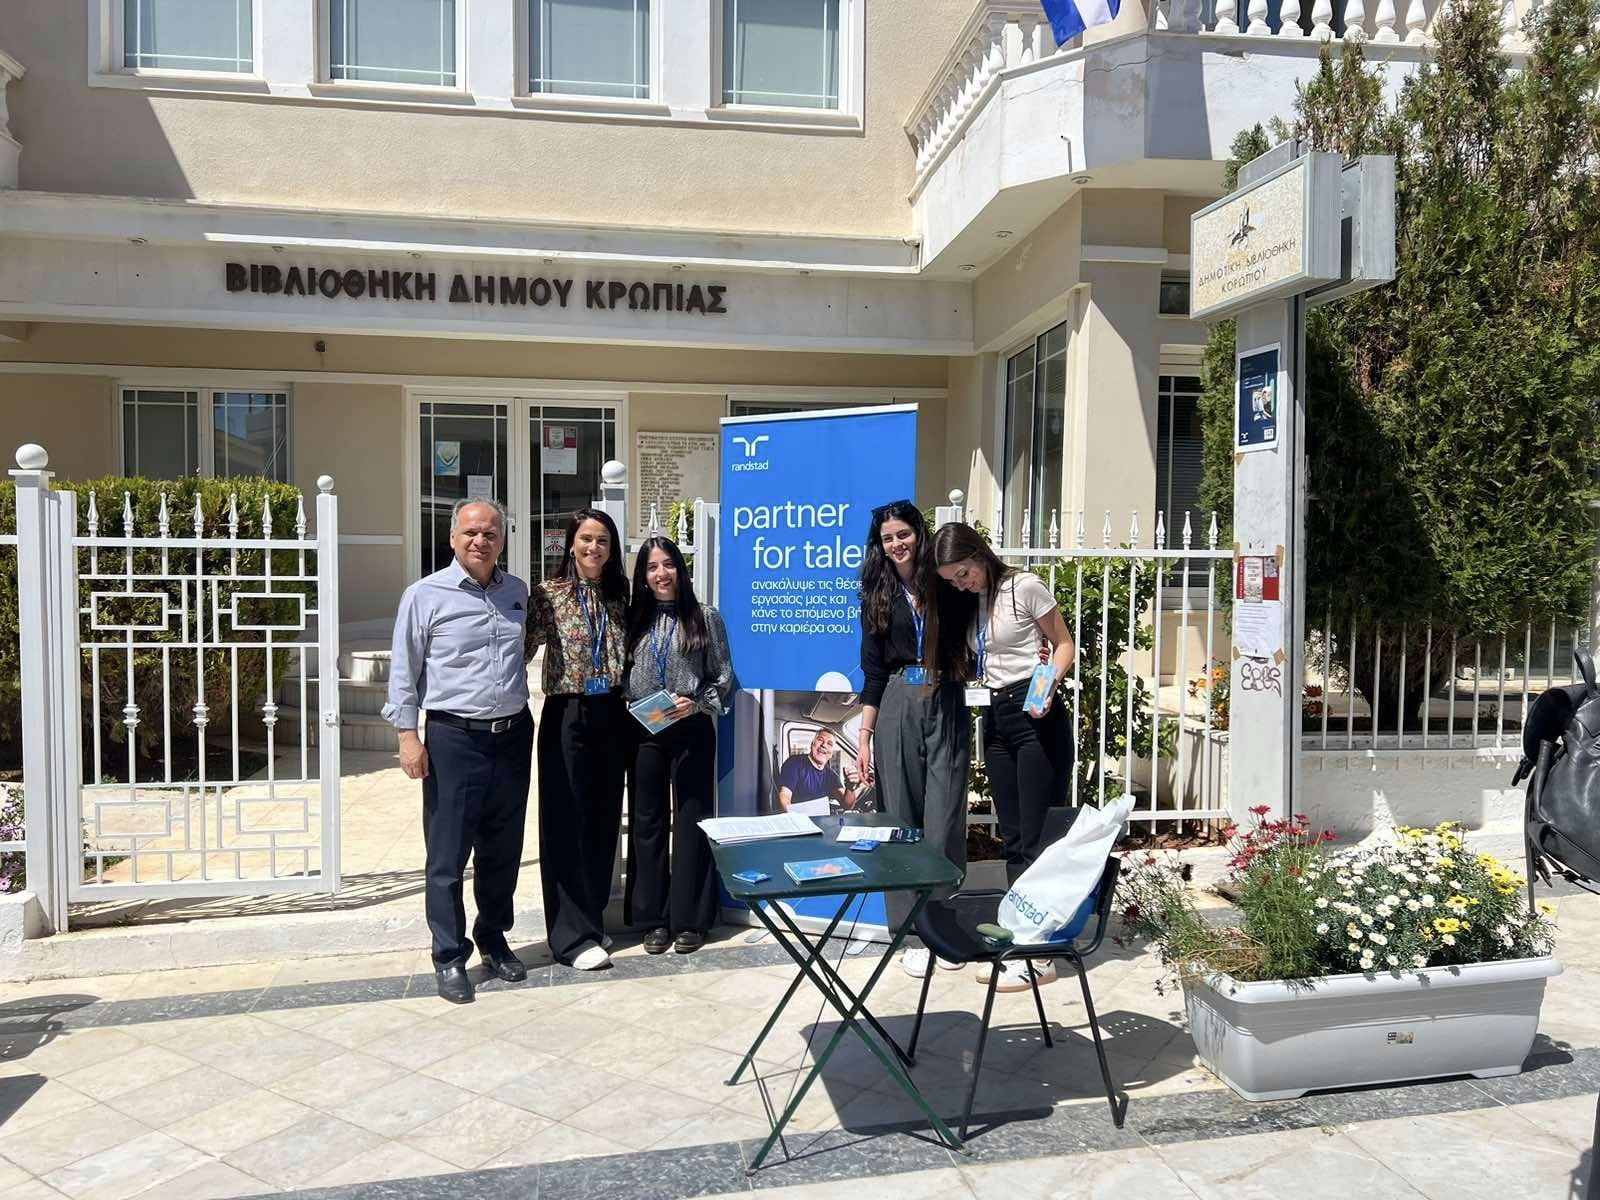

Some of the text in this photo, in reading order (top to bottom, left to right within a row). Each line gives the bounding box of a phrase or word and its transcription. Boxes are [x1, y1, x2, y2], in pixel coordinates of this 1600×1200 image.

[1199, 261, 1242, 287] ΔΗΜΟΤΙΚΗ
[1221, 266, 1267, 293] ΚΟΡΩΠΙΟΥ
[225, 262, 728, 314] ΒΙΒΛΙΟΘΗΚΗ ΔΗΜΟΥ ΚΡΩΠΙΑΣ
[731, 459, 769, 472] randstad
[733, 500, 850, 537] partner
[752, 535, 867, 569] for tale
[751, 577, 864, 592] ανακάλυψε τις θέσε
[751, 592, 847, 606] εργασίας μας και
[751, 606, 862, 621] κάνε το επόμενο βή
[751, 621, 854, 635] στην καριέρα σου.
[1008, 888, 1049, 926] andstad
